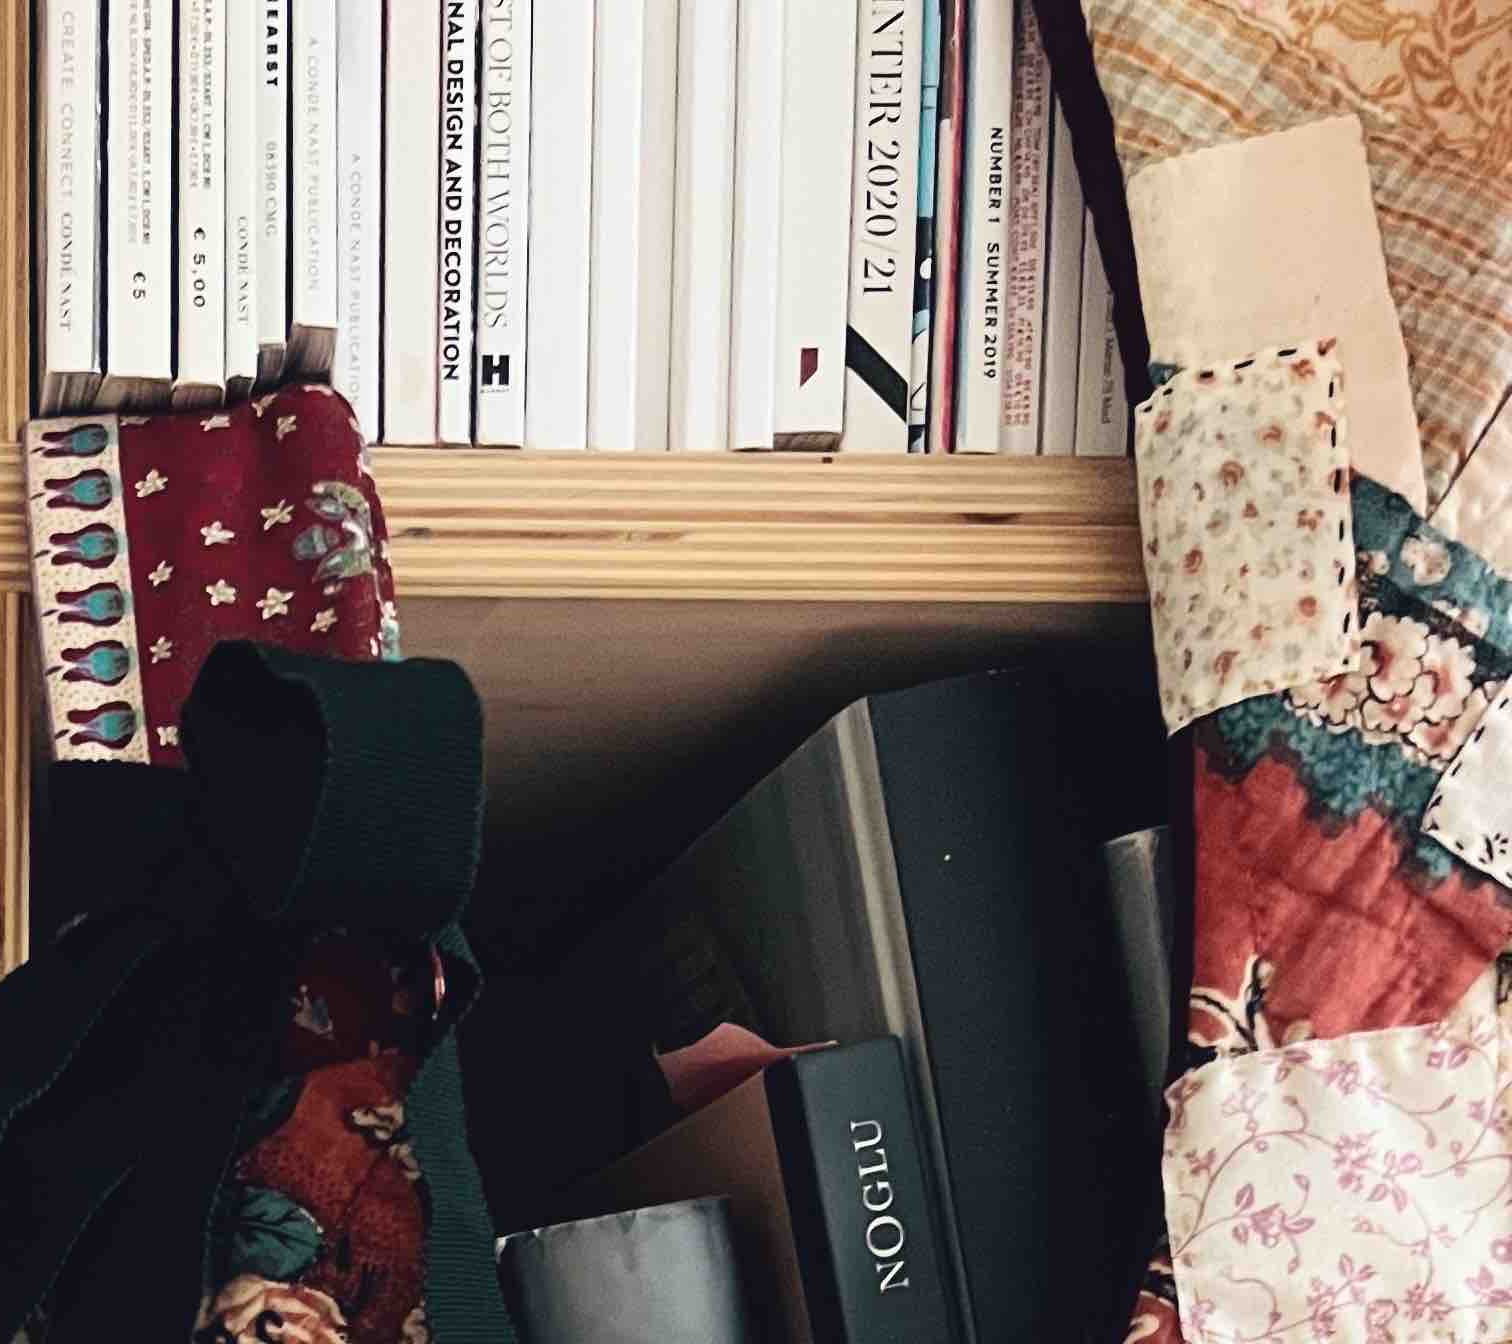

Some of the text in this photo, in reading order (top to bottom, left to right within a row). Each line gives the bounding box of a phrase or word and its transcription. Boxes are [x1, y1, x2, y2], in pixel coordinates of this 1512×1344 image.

[61, 11, 75, 88] CREATE
[265, 0, 279, 88] EARST
[308, 36, 319, 48] A
[487, 38, 512, 82] OF
[60, 103, 75, 199] CONNECT
[307, 123, 320, 170] NAST
[351, 153, 361, 164] A
[485, 91, 511, 182] BOTH
[306, 176, 321, 291] PUBLICATION
[443, 1, 465, 381] NAL DESIGN AND DECORATION
[861, 140, 901, 297] 2020/21
[349, 239, 361, 283] NAST
[483, 190, 509, 328] WORLDS
[982, 127, 1003, 379] NUMBER 1 SUMMER 2019
[58, 281, 74, 331] NAST
[236, 279, 249, 325] NAST
[850, 1119, 910, 1294] NOGLU
